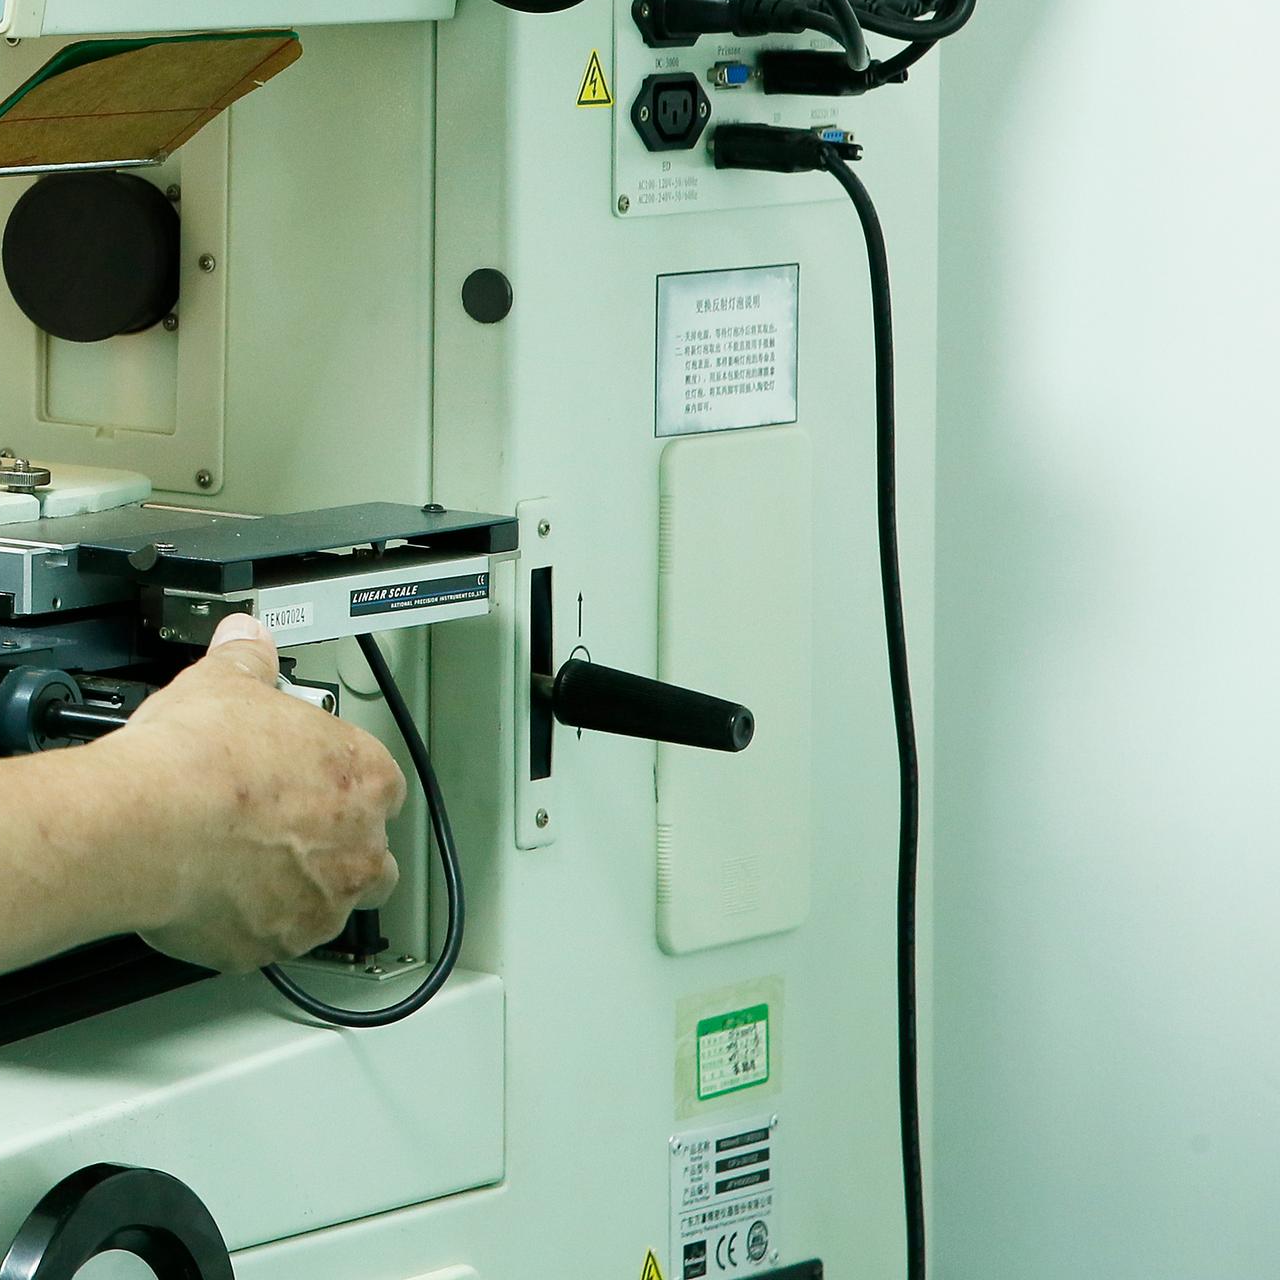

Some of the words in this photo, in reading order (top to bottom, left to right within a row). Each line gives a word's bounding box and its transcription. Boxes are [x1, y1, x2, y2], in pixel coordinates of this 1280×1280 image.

[352, 589, 387, 604] LINEAR
[388, 585, 419, 599] SCALE
[390, 600, 413, 609] RATIONAL
[414, 596, 439, 606] PRECISION
